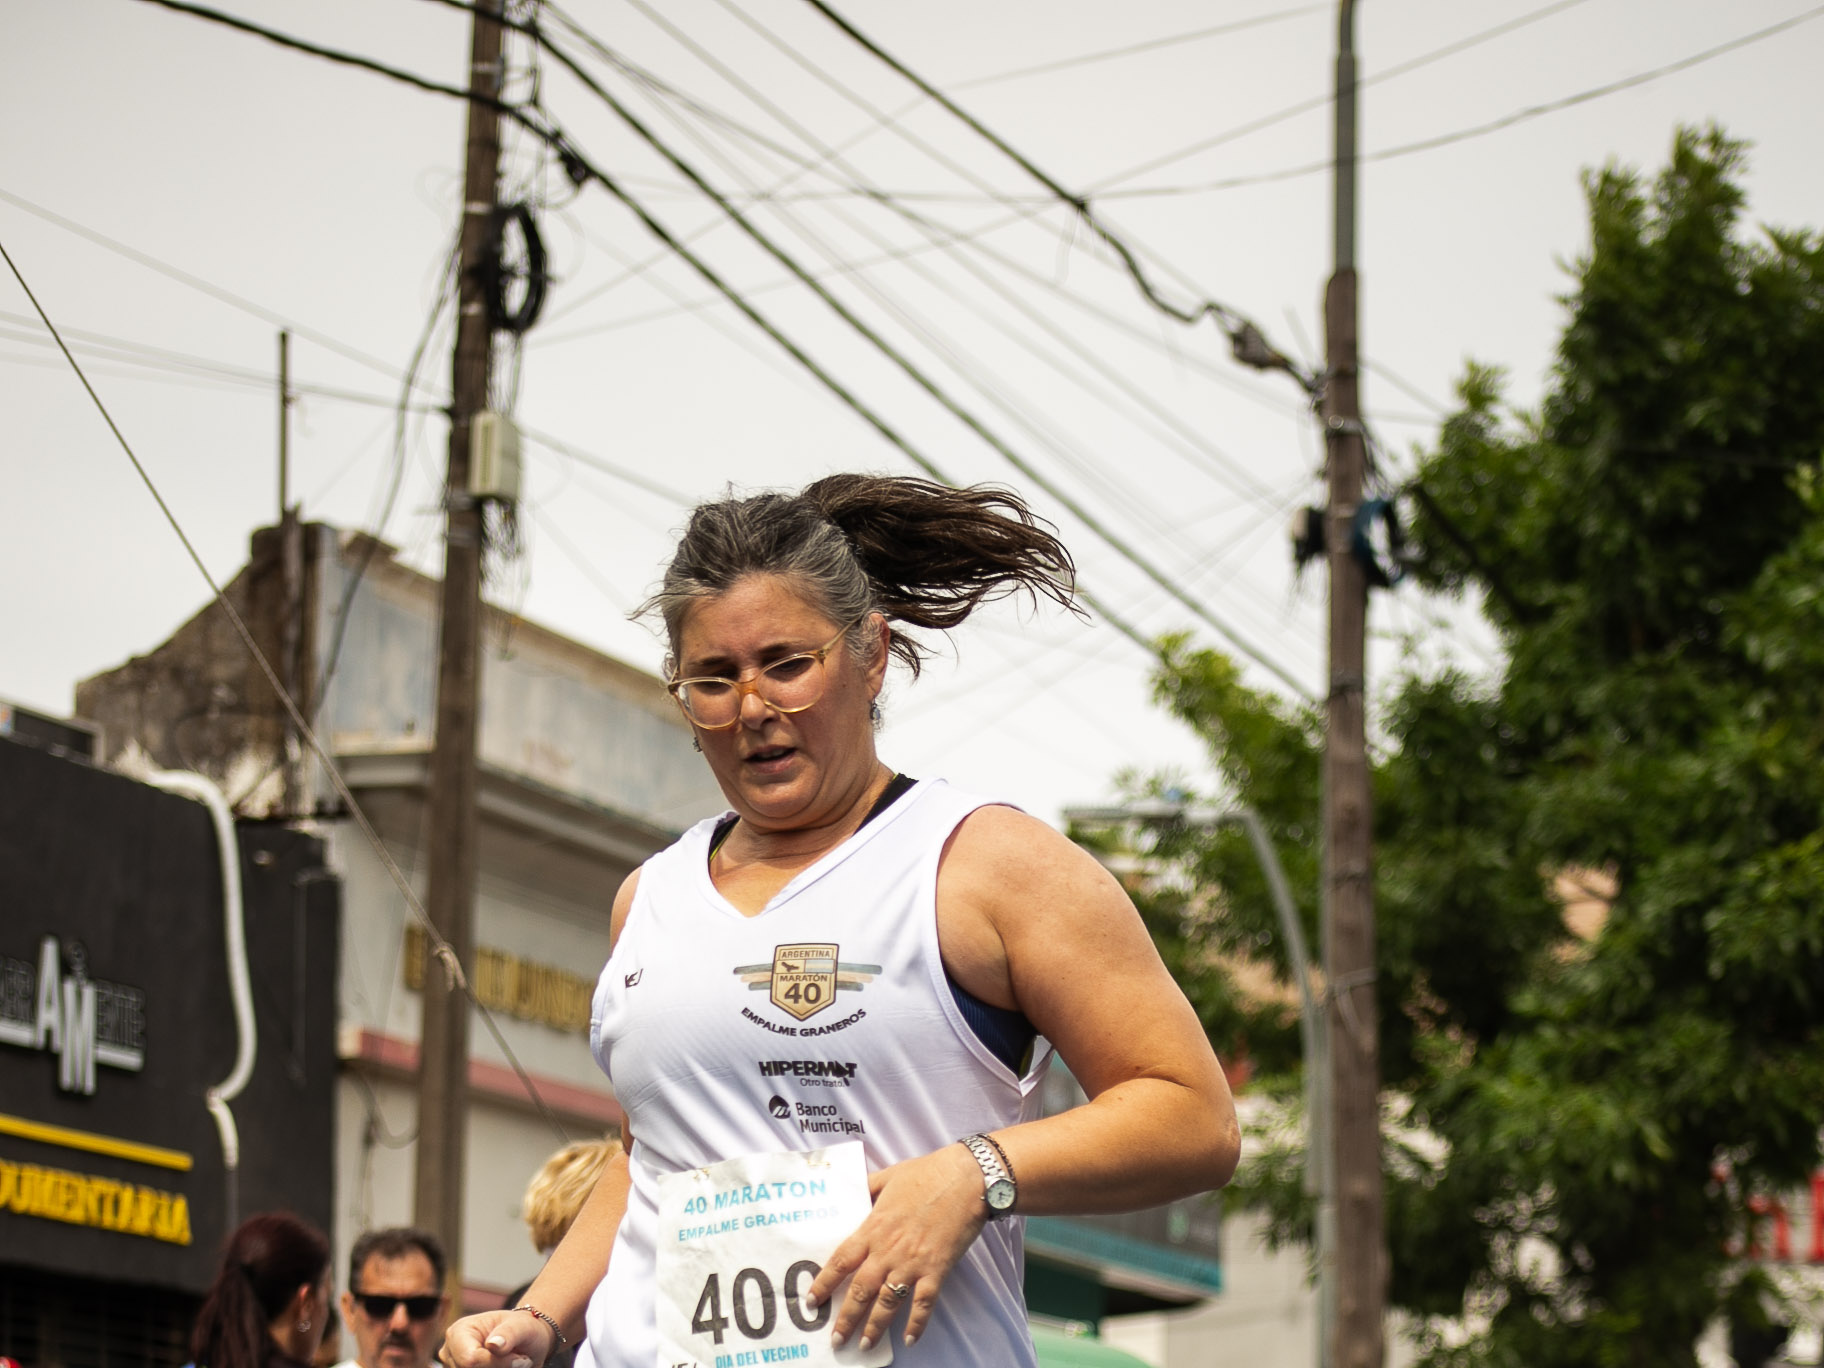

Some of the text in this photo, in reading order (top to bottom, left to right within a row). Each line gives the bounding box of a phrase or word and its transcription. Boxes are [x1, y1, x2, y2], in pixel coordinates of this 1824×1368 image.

[781, 950, 831, 958] ARGENTINA
[779, 972, 828, 982] MARATÓN
[783, 983, 822, 1004] 40
[740, 1007, 867, 1037] EMPALME GRANEROS
[799, 1078, 821, 1087] Otro
[795, 1102, 838, 1116] Banco
[799, 1118, 866, 1136] Municipal
[684, 1179, 827, 1215] 40 MARATON
[678, 1208, 839, 1242] EMPALME GRANEROS
[691, 1260, 832, 1345] 400
[737, 1351, 759, 1368] DEL
[761, 1343, 809, 1365] VECINO
